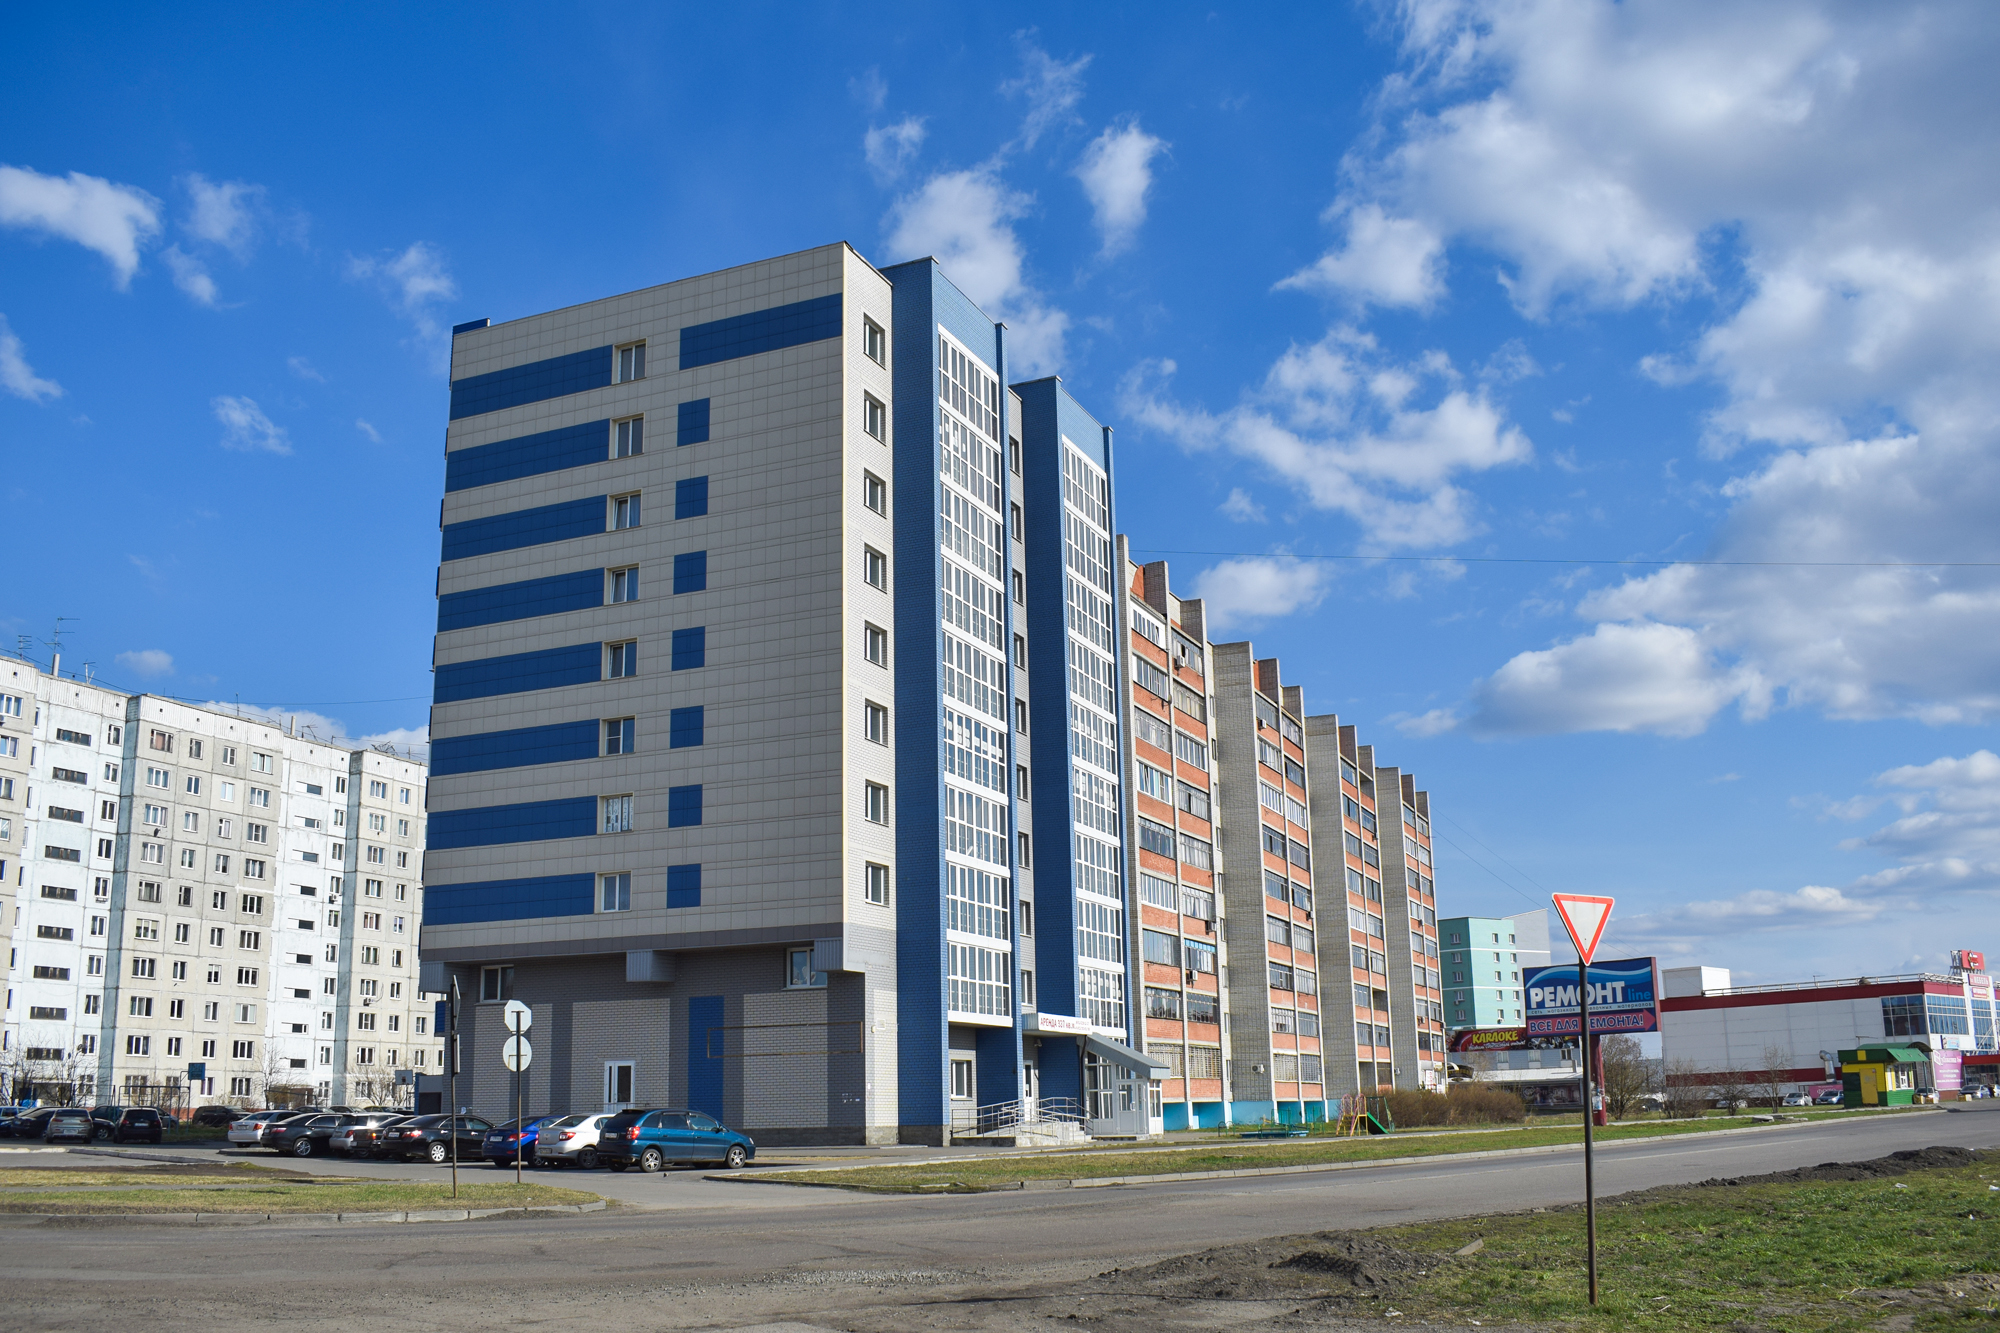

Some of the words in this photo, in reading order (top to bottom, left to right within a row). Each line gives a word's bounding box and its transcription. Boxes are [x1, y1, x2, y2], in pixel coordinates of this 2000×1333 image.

[1529, 981, 1625, 1009] РЕМОНТ
[1627, 988, 1651, 1001] line
[1040, 1017, 1057, 1028] АРЕНДА
[1530, 1020, 1552, 1033] ВСЕ
[1555, 1018, 1579, 1031] ДЛЯ
[1588, 1014, 1643, 1029] ЕМОНТА!
[1472, 1030, 1519, 1044] KARAOKE
